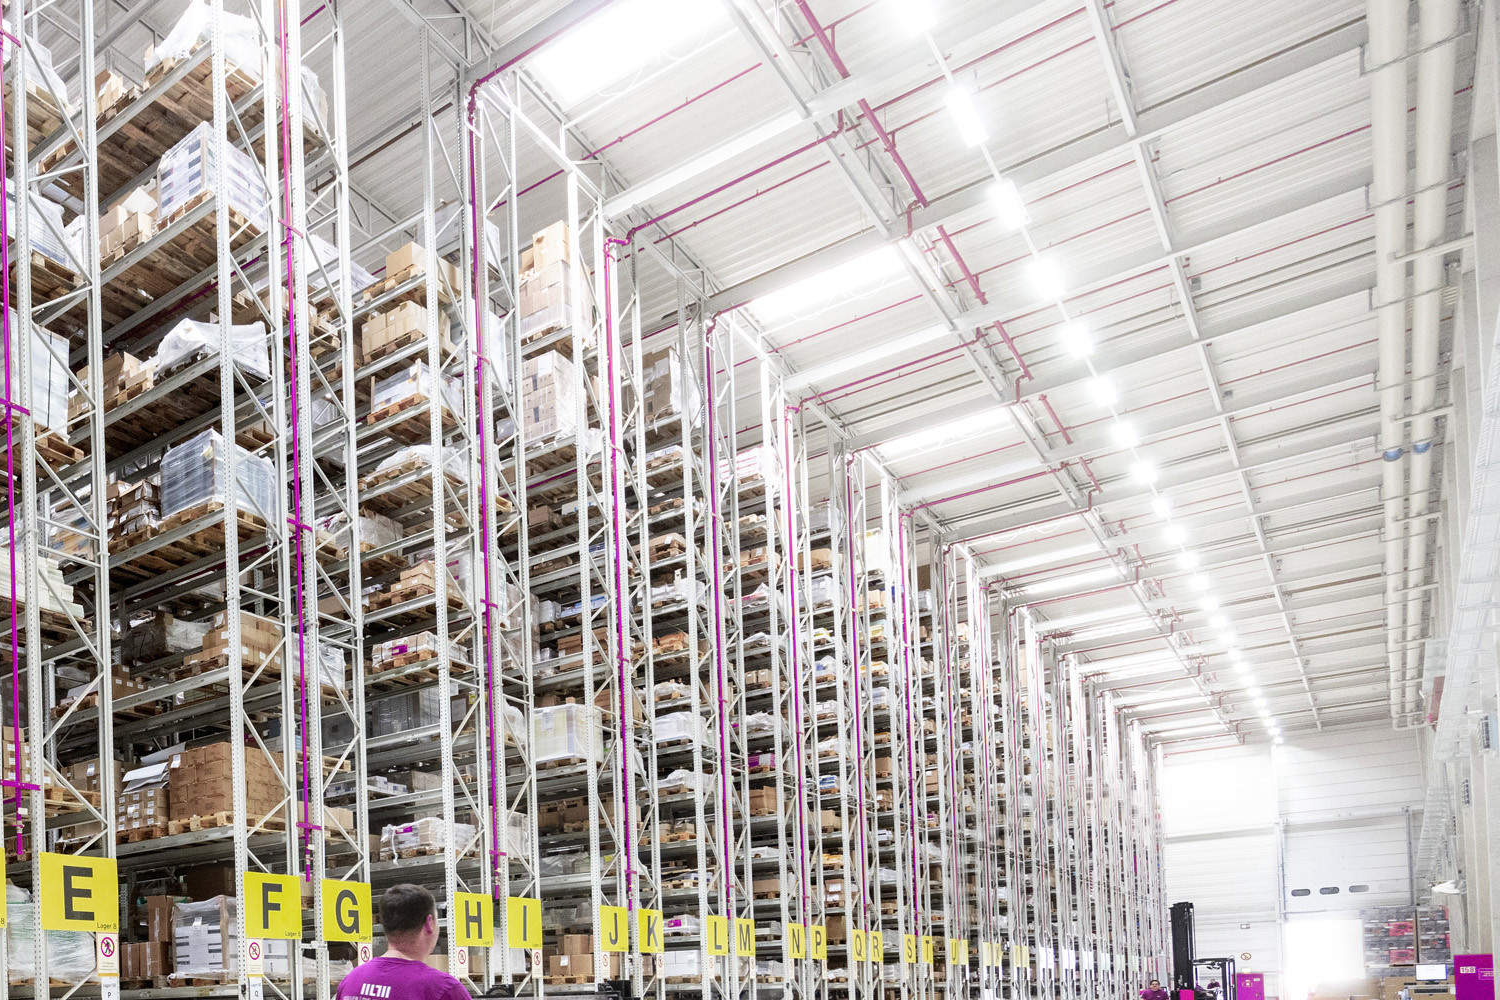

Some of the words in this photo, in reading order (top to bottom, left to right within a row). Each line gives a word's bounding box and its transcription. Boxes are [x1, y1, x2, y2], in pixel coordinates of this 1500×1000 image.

[63, 865, 95, 921] E
[262, 883, 282, 929] F
[335, 889, 360, 934] G
[465, 900, 482, 939] H
[523, 905, 527, 941] I
[609, 913, 618, 945] J
[647, 915, 658, 947] K
[714, 922, 722, 950] L
[739, 923, 751, 951] M
[792, 928, 800, 953] N
[815, 930, 821, 954] P
[855, 934, 862, 957] Q
[872, 935, 879, 958] R
[907, 938, 912, 958] S
[925, 940, 930, 958] T
